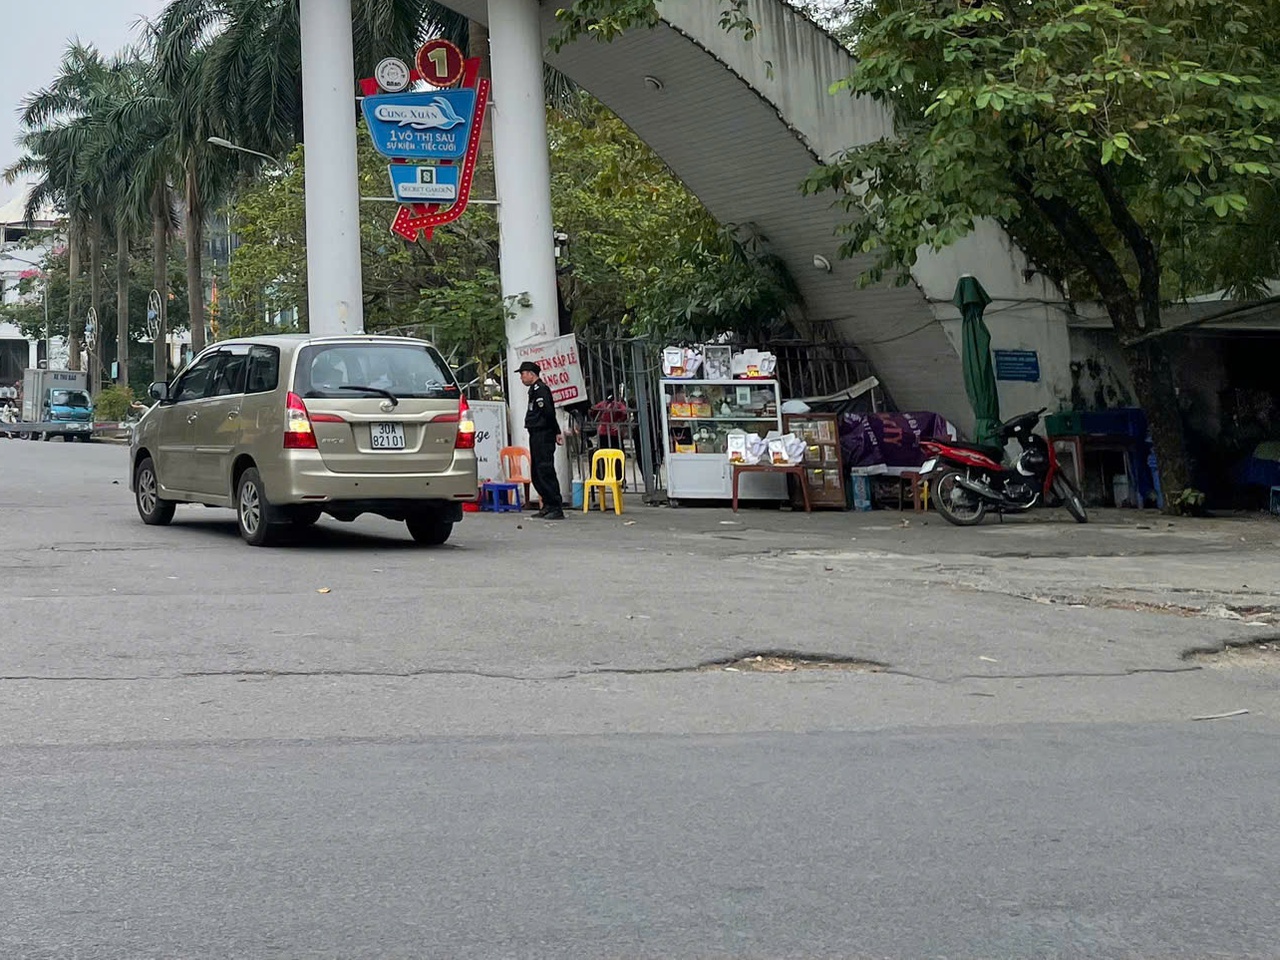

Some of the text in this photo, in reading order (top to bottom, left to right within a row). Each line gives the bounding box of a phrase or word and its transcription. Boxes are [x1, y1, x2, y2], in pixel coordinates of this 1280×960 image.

[427, 47, 448, 78] 1
[389, 129, 398, 141] 1
[398, 130, 413, 141] VÕ
[378, 423, 397, 435] 30A
